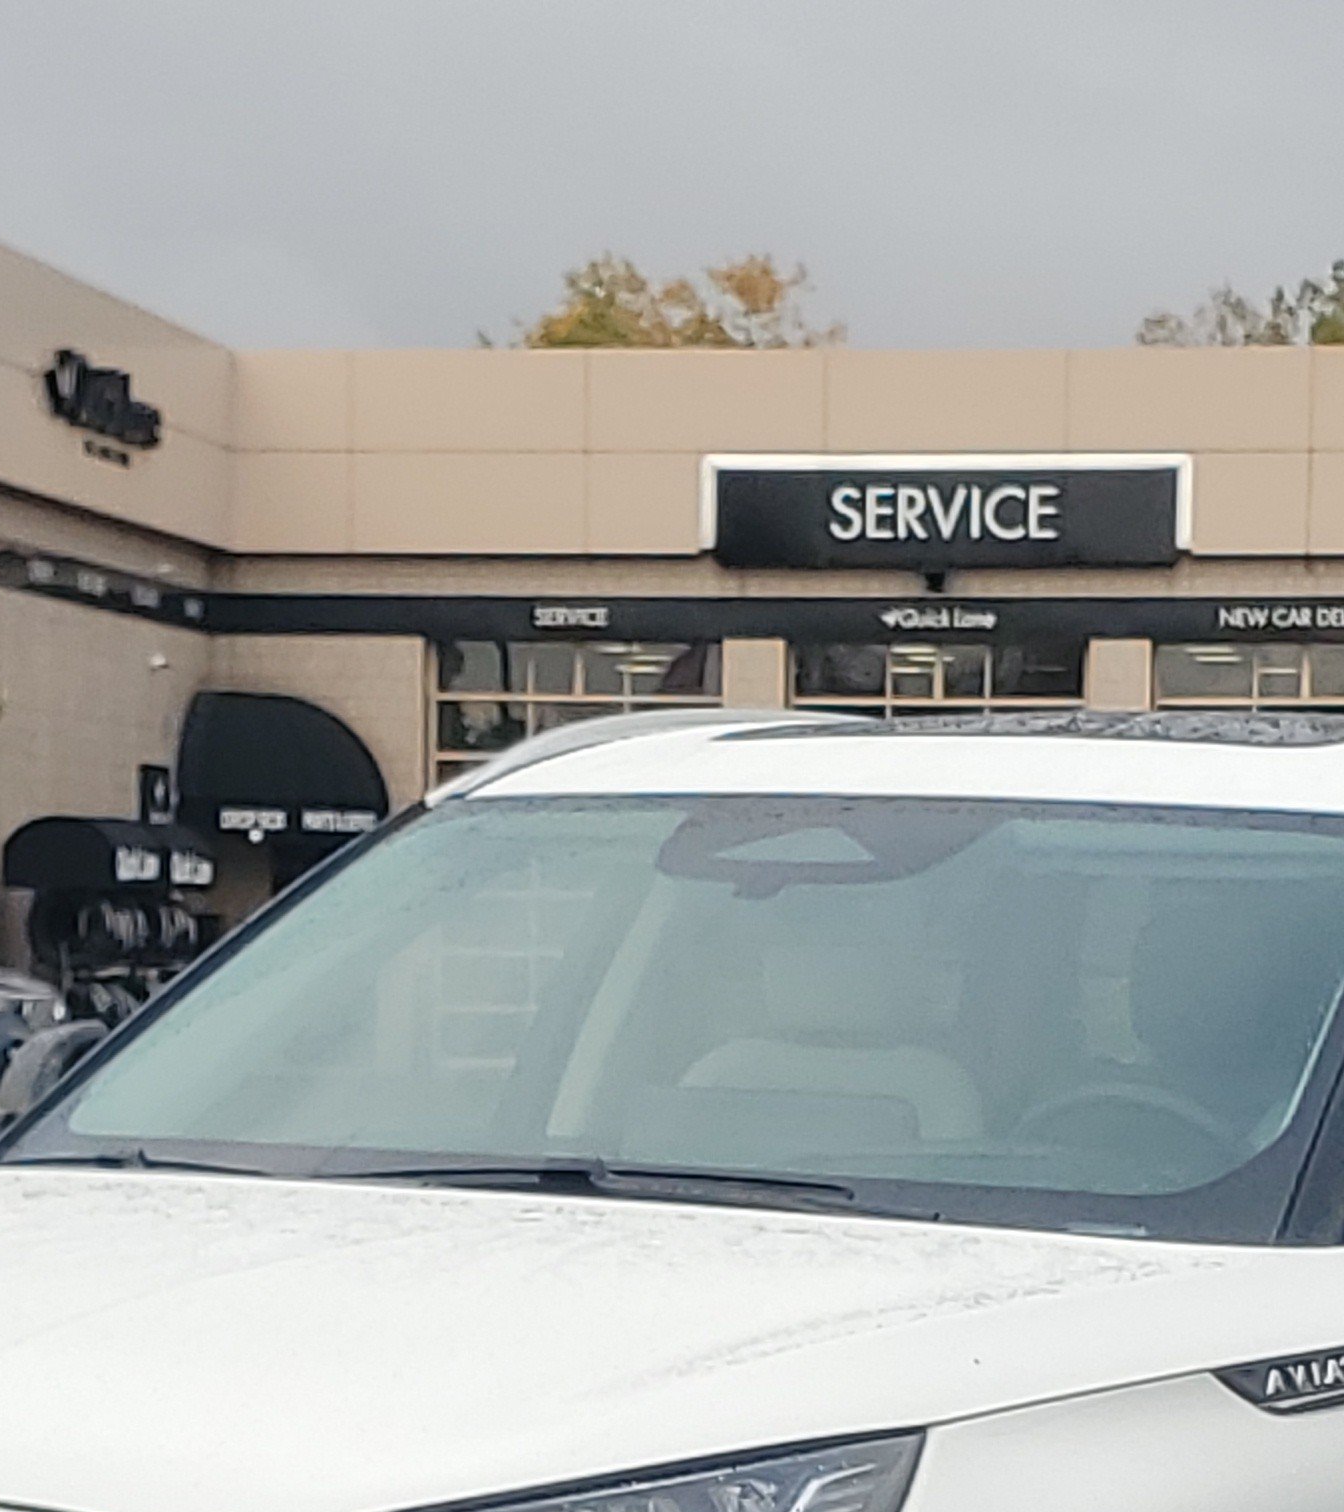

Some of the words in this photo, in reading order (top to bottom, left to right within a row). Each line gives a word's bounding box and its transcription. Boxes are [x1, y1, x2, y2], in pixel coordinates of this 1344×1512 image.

[828, 483, 1061, 541] SERVICE
[533, 606, 610, 628] SERVICE
[897, 607, 950, 629] Quick
[953, 606, 997, 629] Lane
[1219, 606, 1268, 629] NEW
[1271, 606, 1312, 628] CAR
